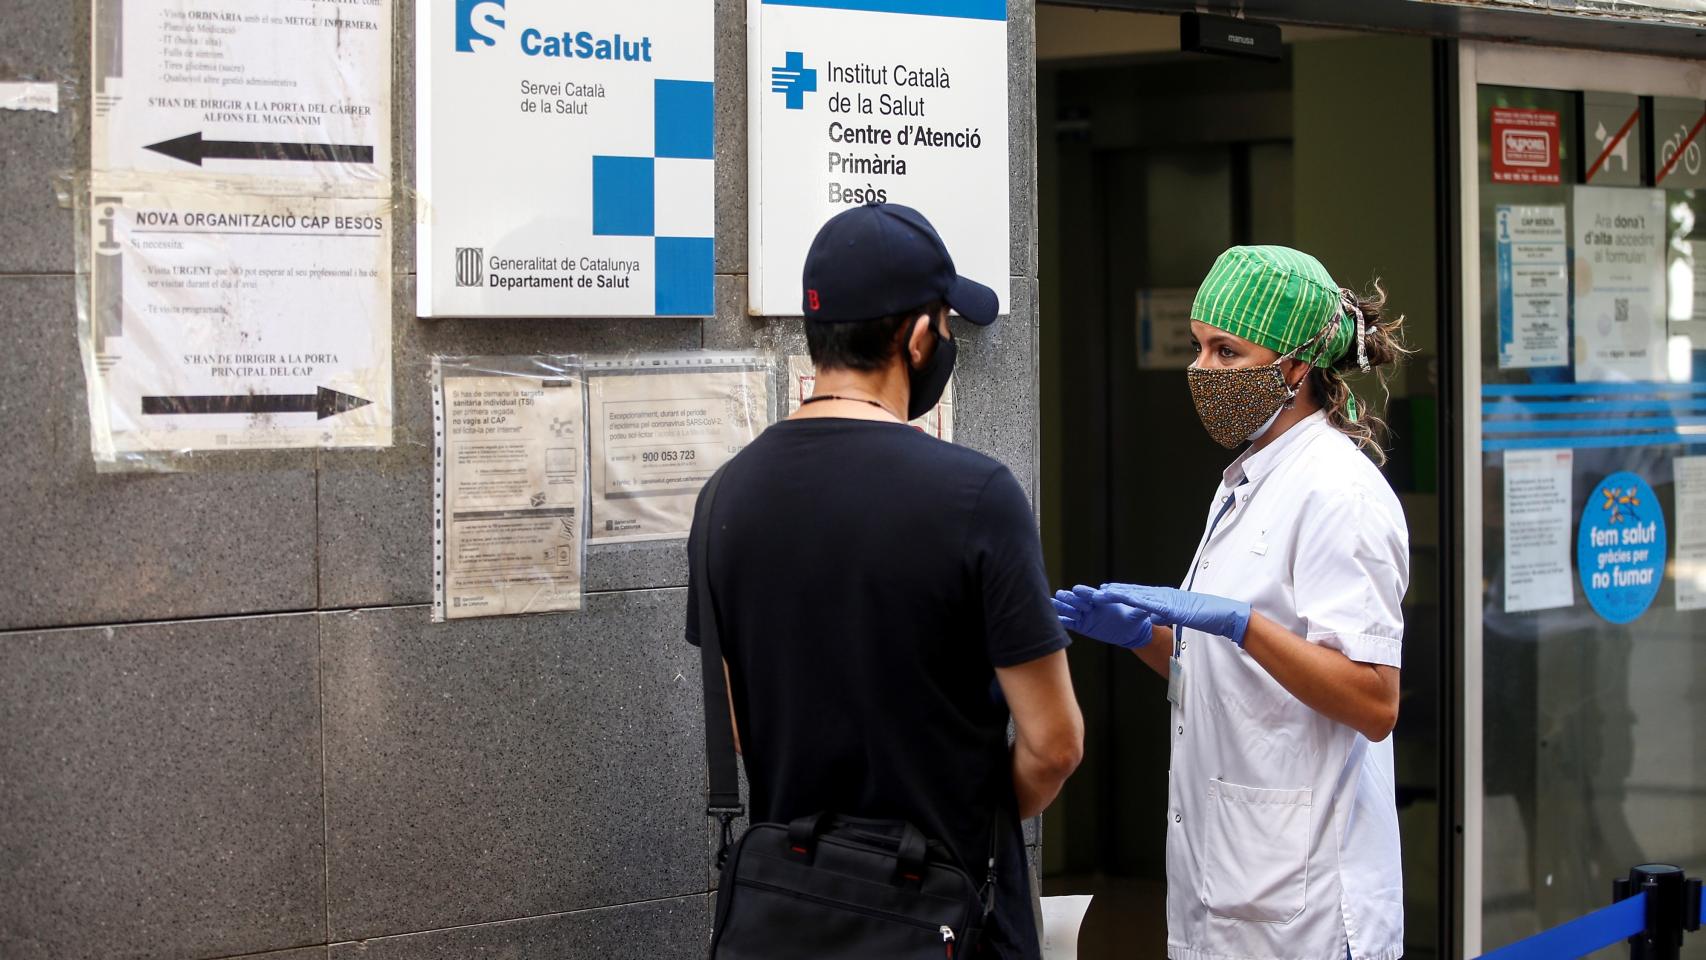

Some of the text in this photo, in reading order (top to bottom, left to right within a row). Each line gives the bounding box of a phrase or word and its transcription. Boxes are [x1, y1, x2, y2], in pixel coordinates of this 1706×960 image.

[285, 16, 316, 26] METGE
[324, 18, 378, 30] INFERMERA
[520, 28, 652, 62] CatSalut
[1228, 35, 1254, 45] manusa
[827, 61, 950, 89] Institut Català
[520, 80, 605, 98] Servei Català
[183, 98, 198, 108] DE
[200, 99, 242, 109] DIRIGIR
[244, 101, 252, 110] A
[254, 101, 268, 111] LA
[271, 102, 305, 112] PORTA
[308, 103, 327, 113] DEL
[520, 99, 588, 115] de la Salut
[828, 92, 925, 117] de la Salut
[203, 112, 243, 122] ALFONS
[246, 114, 260, 123] EL
[828, 122, 981, 149] Centre d'Atenció
[828, 152, 906, 175] Primària
[828, 182, 887, 204] Besòs
[136, 212, 179, 226] NOVA
[301, 215, 330, 228] CAP
[172, 265, 212, 275] URGENT
[489, 256, 640, 279] Generalitat de Catalunya
[489, 274, 630, 290] Departament de Salut
[808, 289, 820, 311] B
[218, 354, 233, 364] DE
[235, 354, 276, 364] DIRIGIR
[279, 354, 286, 364] A
[288, 354, 301, 364] LA
[304, 354, 338, 364] PORTA
[211, 366, 313, 377] PRINCIPAL DEL CAP
[642, 452, 659, 462] 900
[661, 451, 678, 461] 053
[680, 450, 695, 460] 723
[1590, 526, 1618, 547] fem
[1622, 521, 1656, 544] salut
[1597, 549, 1648, 569] gràcies per
[1592, 568, 1654, 588] no fumar
